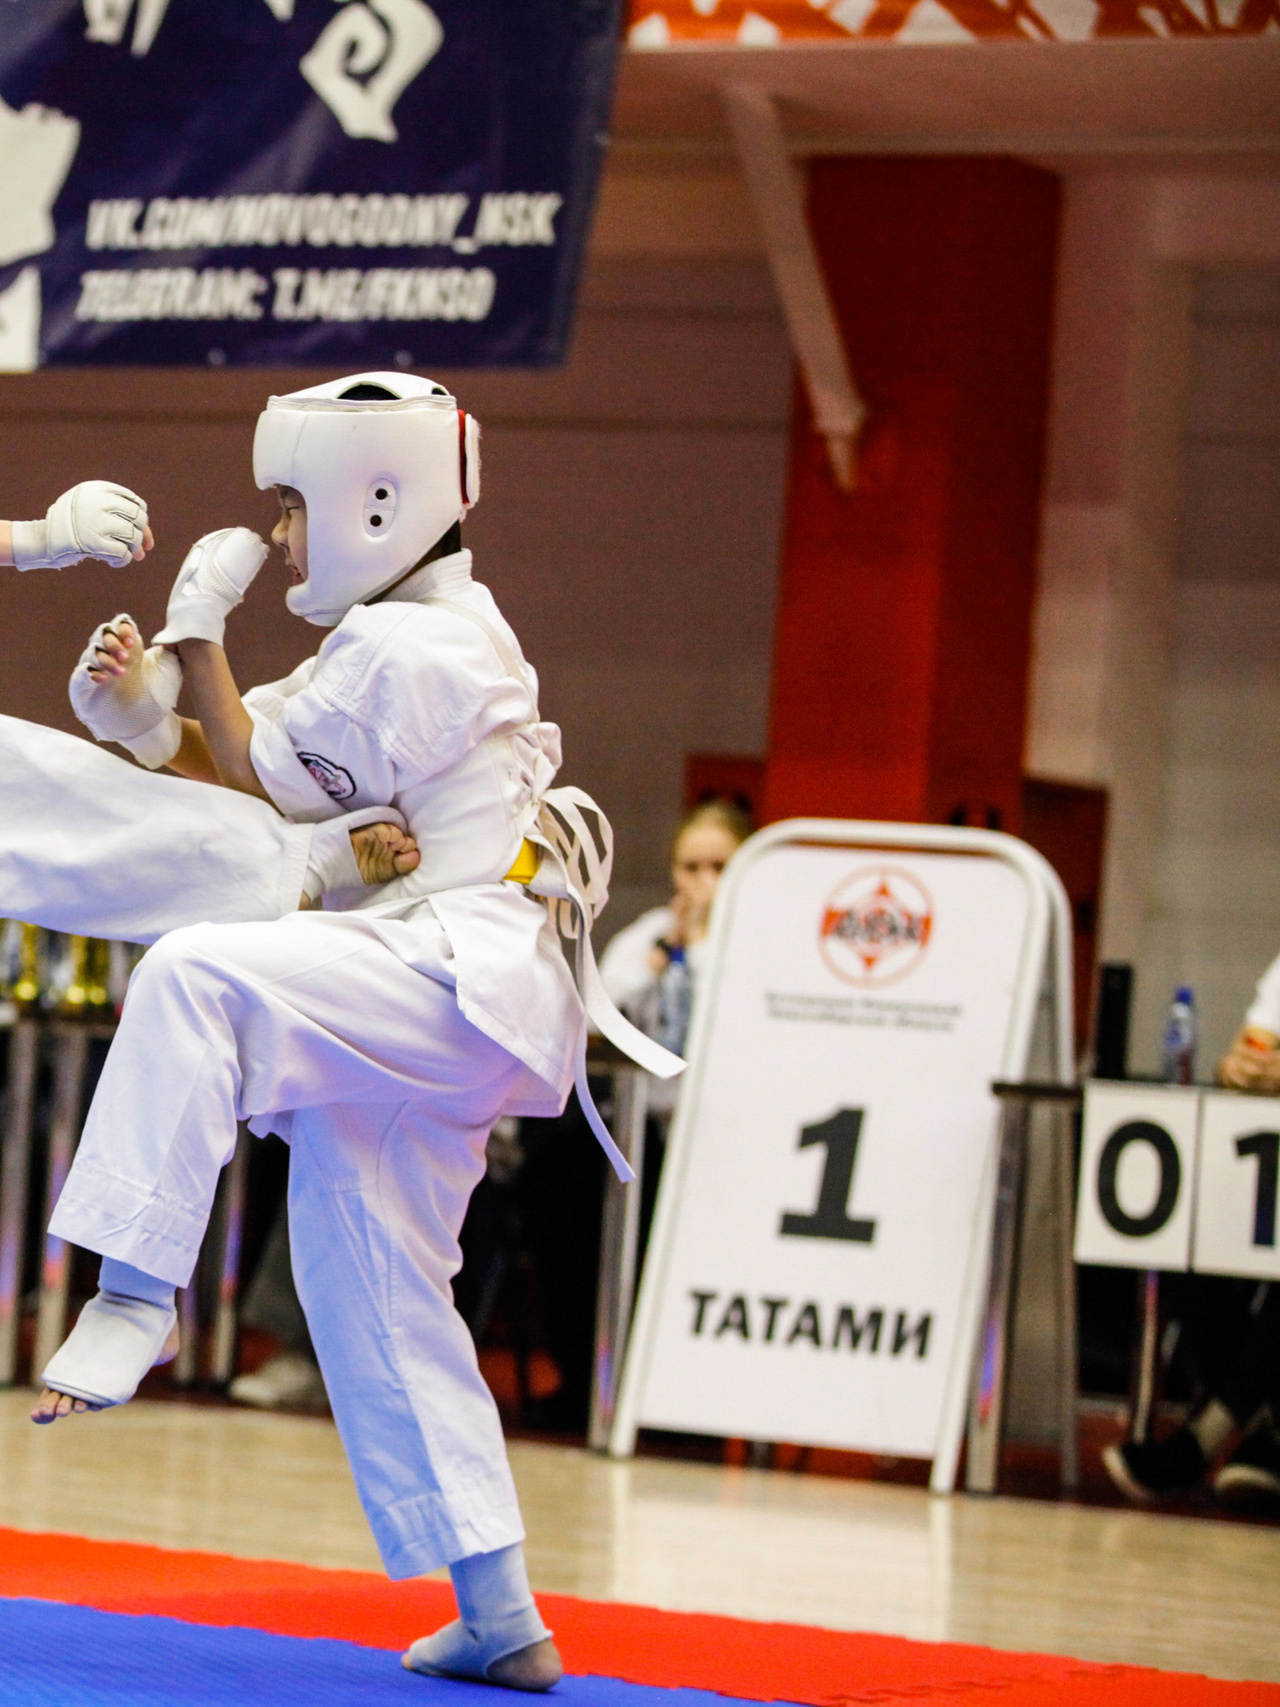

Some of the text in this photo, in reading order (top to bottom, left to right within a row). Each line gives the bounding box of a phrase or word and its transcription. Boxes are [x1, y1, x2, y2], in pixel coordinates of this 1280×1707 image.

[85, 191, 564, 254] VK.COM/NOVOGODNY_NSK
[74, 266, 497, 322] TELEGRAM: T.ME/FKNSO
[778, 1104, 877, 1245] 1
[688, 1288, 933, 1362] ТАТАМИ
